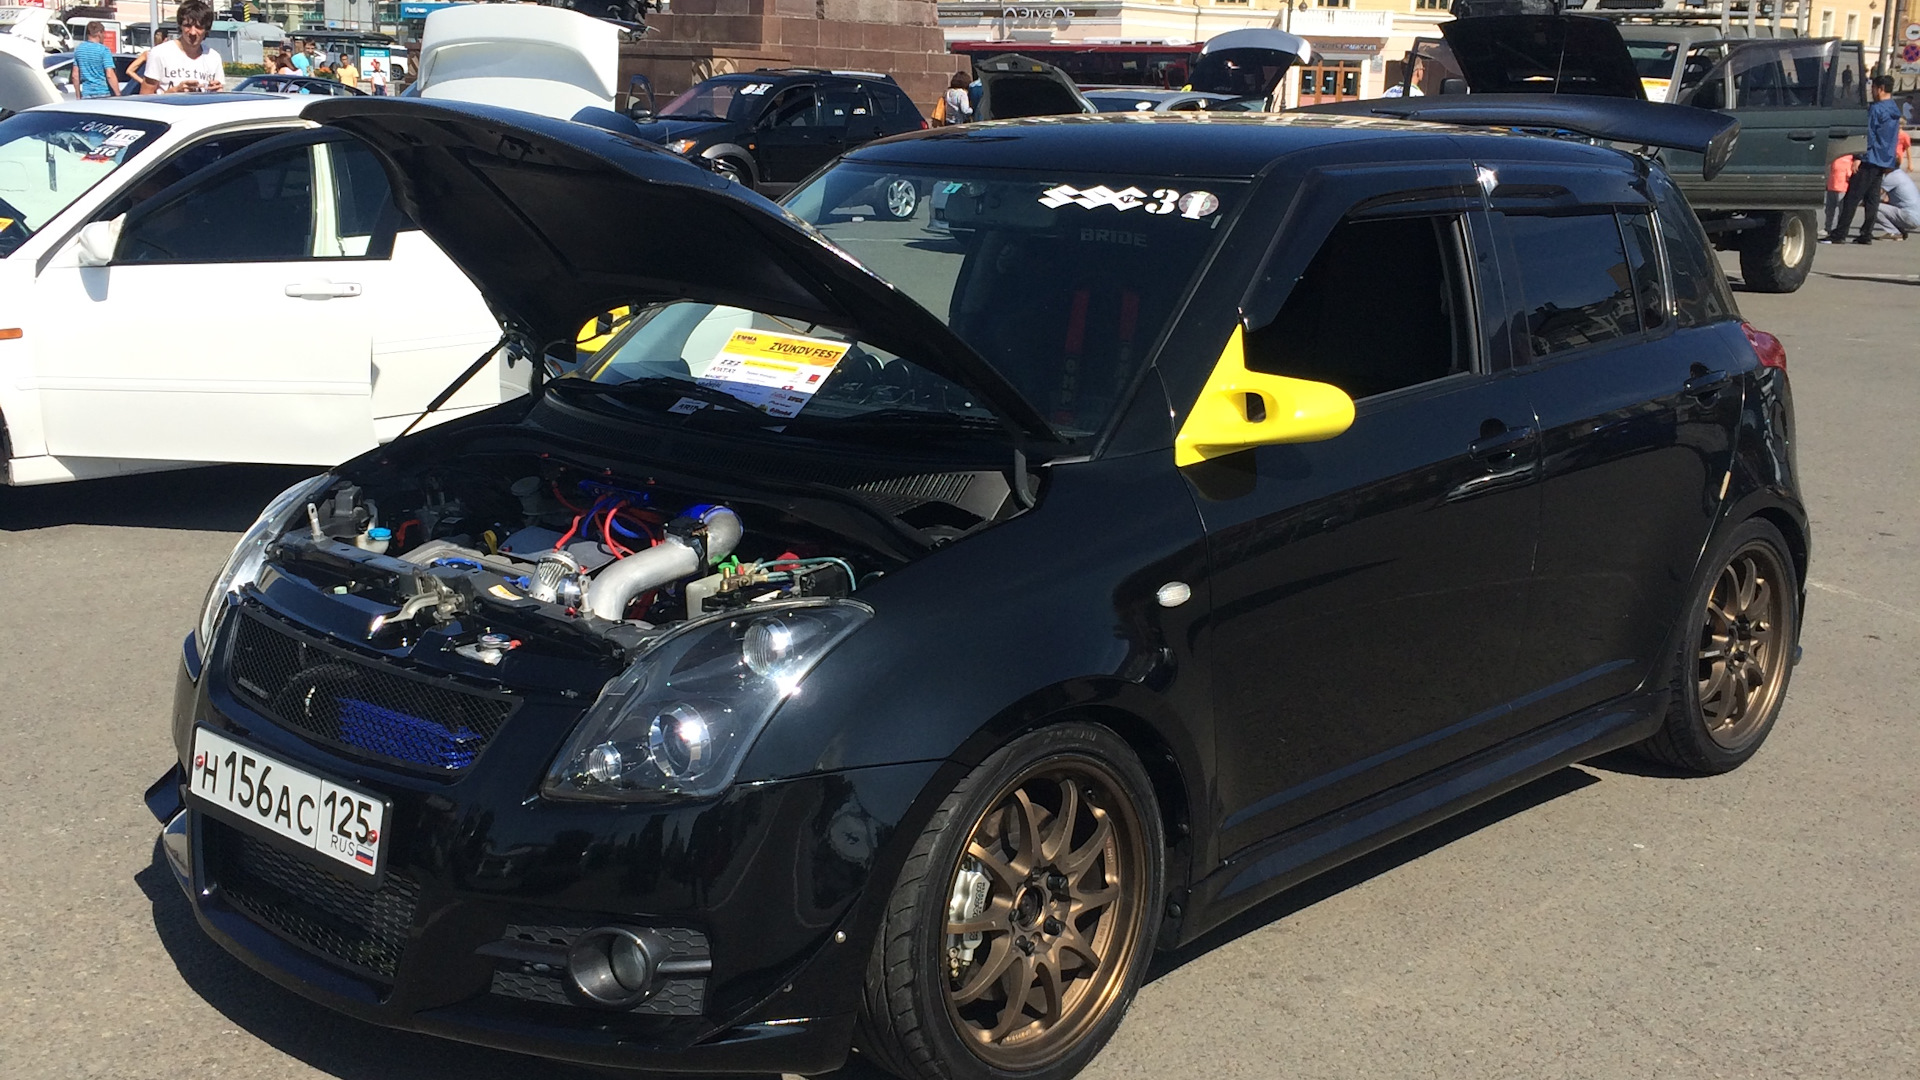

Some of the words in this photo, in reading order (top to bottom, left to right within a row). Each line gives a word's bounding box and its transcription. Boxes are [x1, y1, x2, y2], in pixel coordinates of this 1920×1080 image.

[164, 67, 191, 78] Let's
[1080, 228, 1148, 247] BRIDE
[812, 348, 842, 360] FEST
[202, 751, 315, 836] H156AC
[324, 790, 372, 844] 125
[331, 834, 355, 857] RUS
